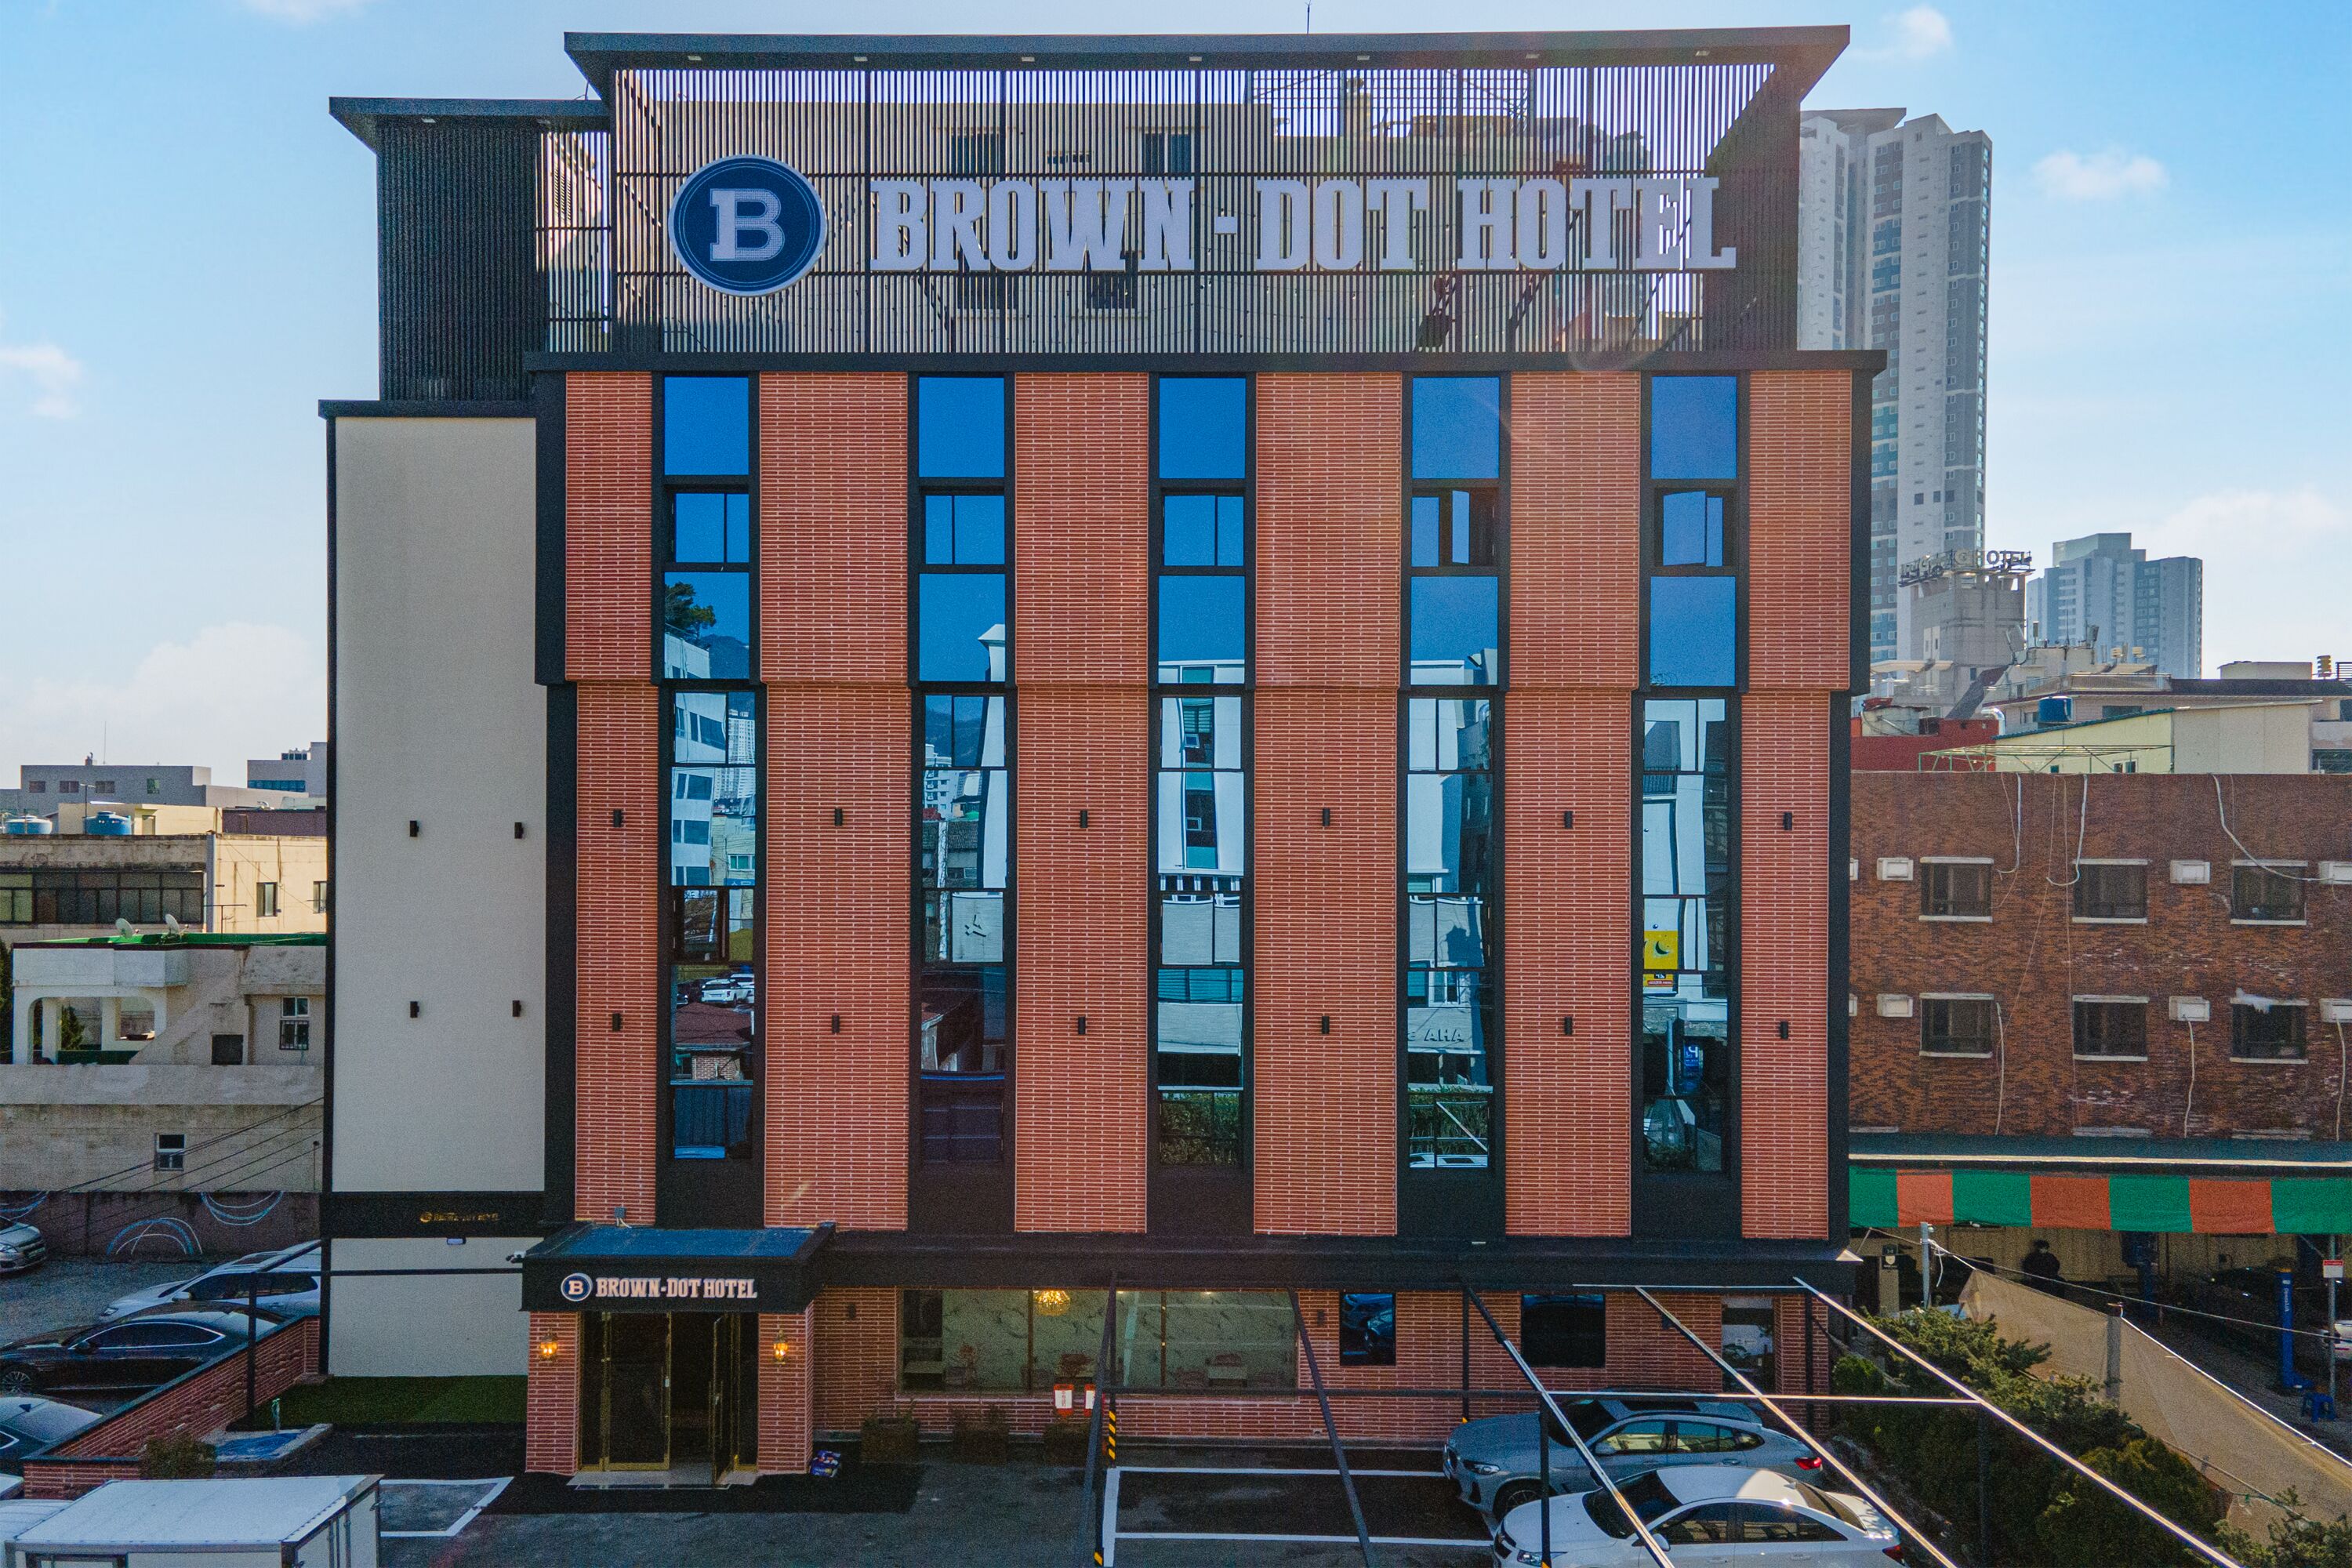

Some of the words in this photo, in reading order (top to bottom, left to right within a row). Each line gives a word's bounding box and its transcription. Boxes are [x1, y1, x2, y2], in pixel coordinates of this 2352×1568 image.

[710, 188, 785, 261] B
[1457, 177, 1737, 270] HOTEL
[568, 1280, 584, 1294] B
[703, 1279, 757, 1298] HOTEL
